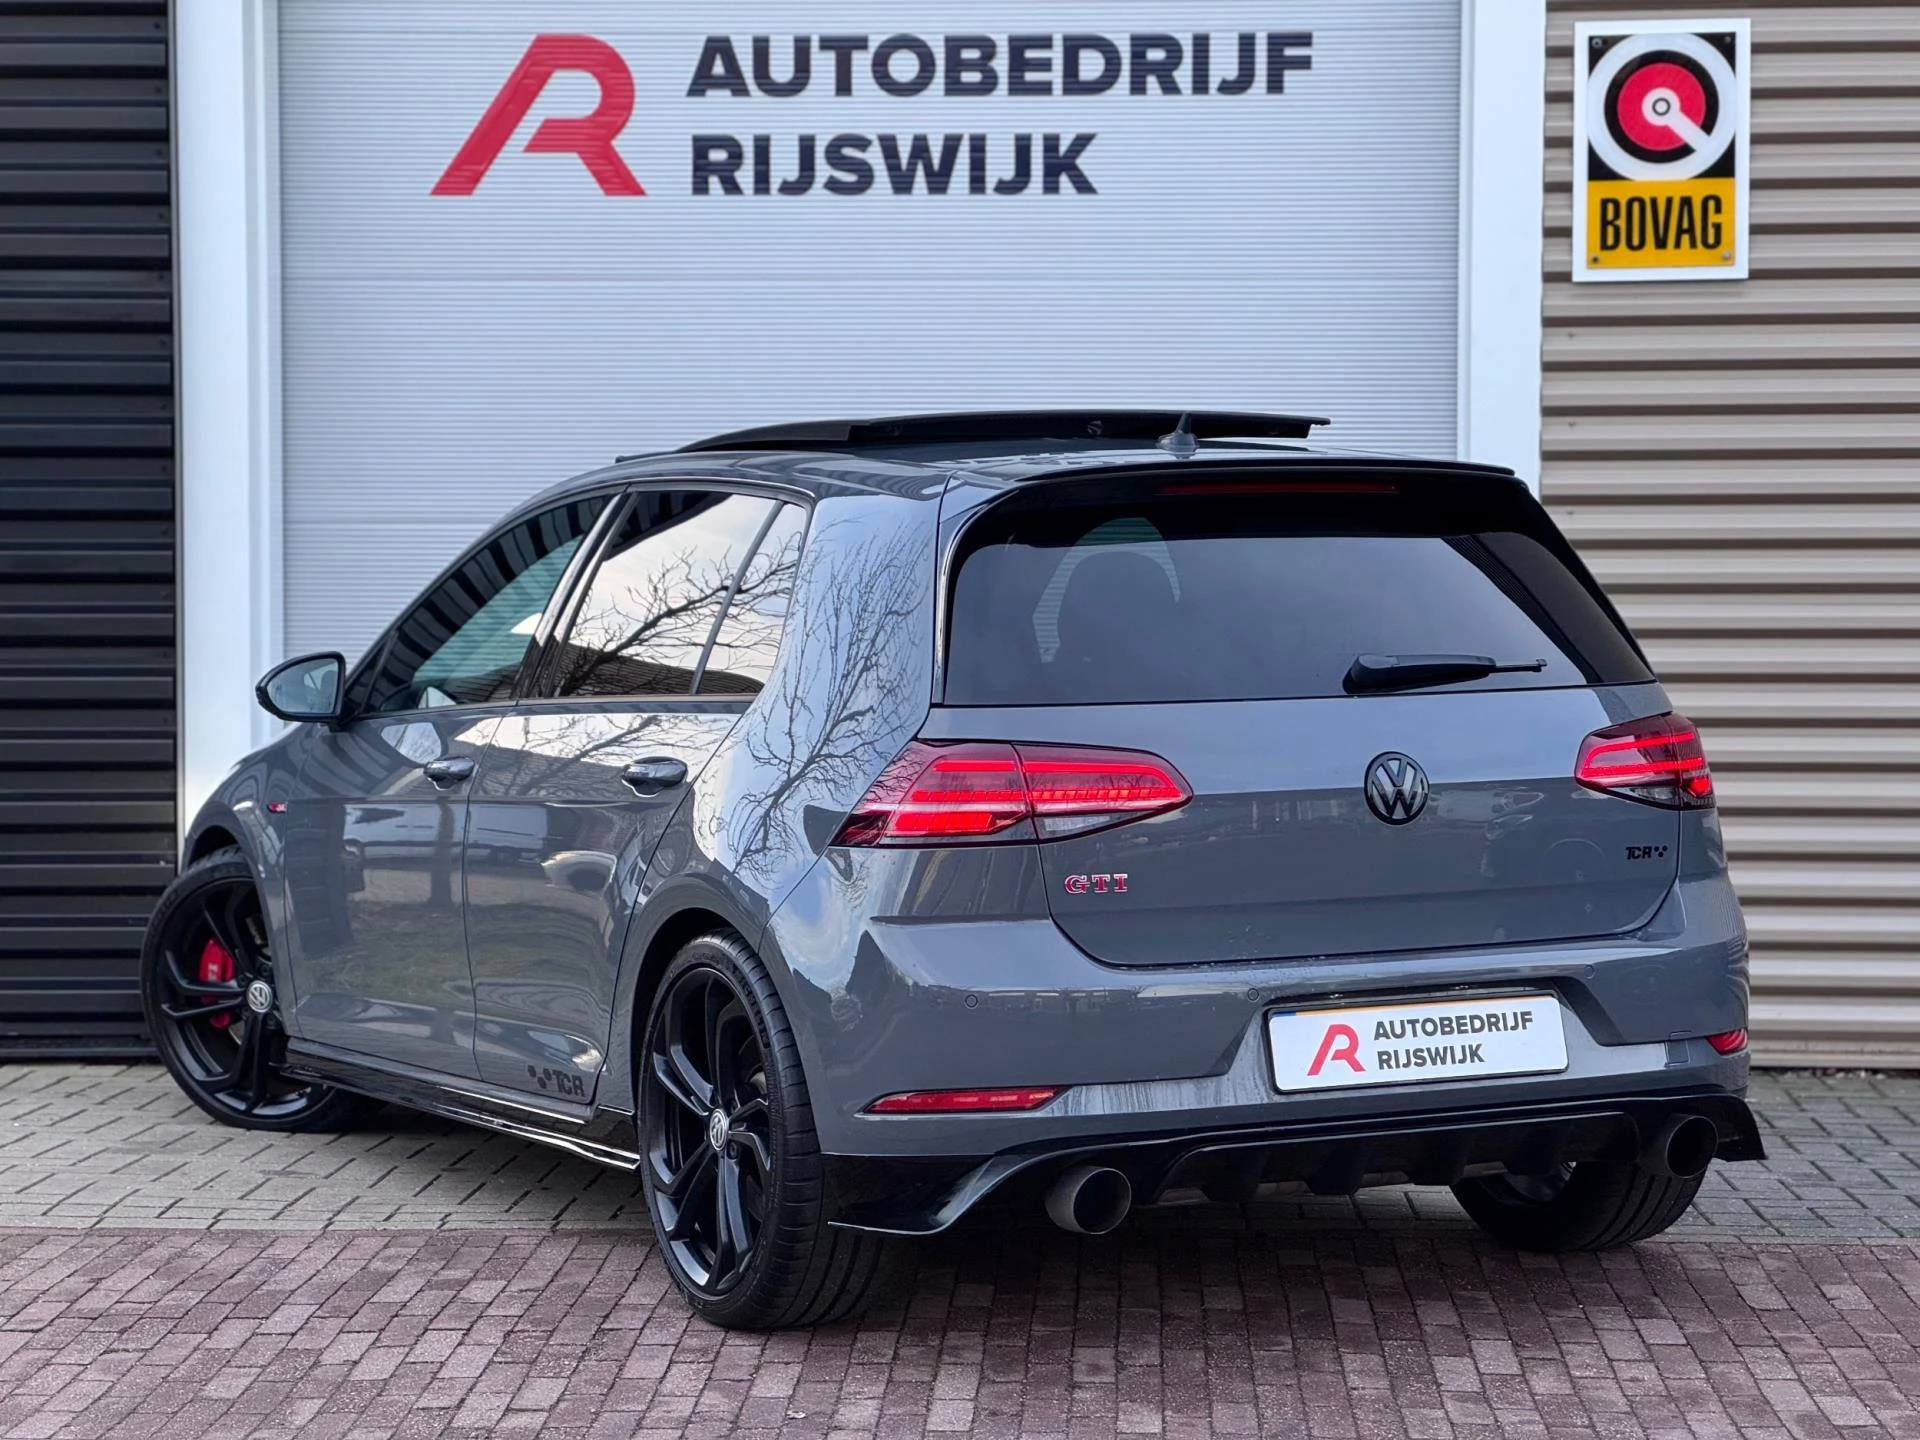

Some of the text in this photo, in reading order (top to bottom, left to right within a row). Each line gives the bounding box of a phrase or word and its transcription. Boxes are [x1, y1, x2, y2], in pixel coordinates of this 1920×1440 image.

[687, 32, 1312, 97] AUTOBEDRIJF
[691, 133, 1098, 196] RIJSWIJK
[1600, 194, 1723, 251] BOVAG
[1064, 873, 1128, 894] GTI
[1374, 1011, 1533, 1040] AUTOBEDRIJF
[1377, 1044, 1484, 1070] RIJSWIJK
